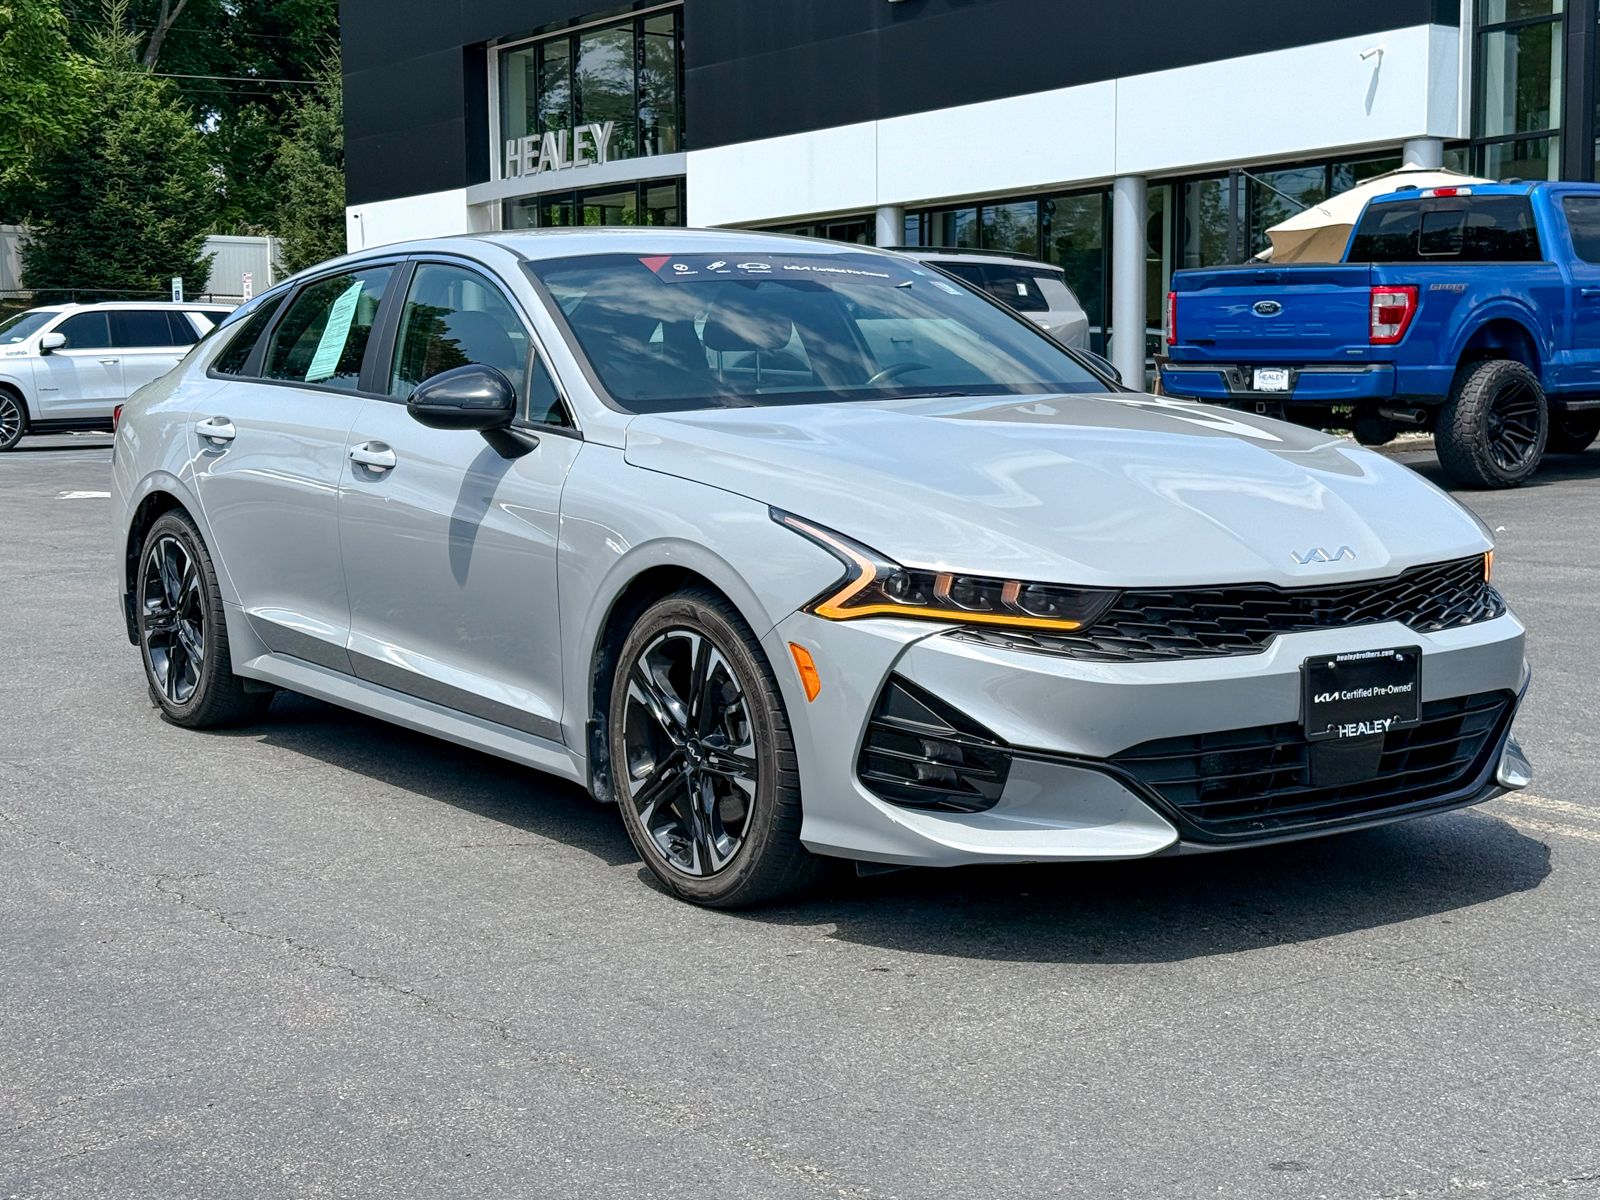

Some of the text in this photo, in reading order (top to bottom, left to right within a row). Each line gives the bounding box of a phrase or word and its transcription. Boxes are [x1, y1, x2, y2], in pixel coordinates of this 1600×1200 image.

[505, 121, 615, 179] HEALEY
[1258, 373, 1285, 381] HEALEY
[1289, 545, 1357, 565] KIA
[1336, 649, 1395, 662] healeybrothers.com
[1314, 691, 1340, 704] KIA
[1341, 687, 1373, 701] Certified
[1338, 718, 1392, 738] HEALEY
